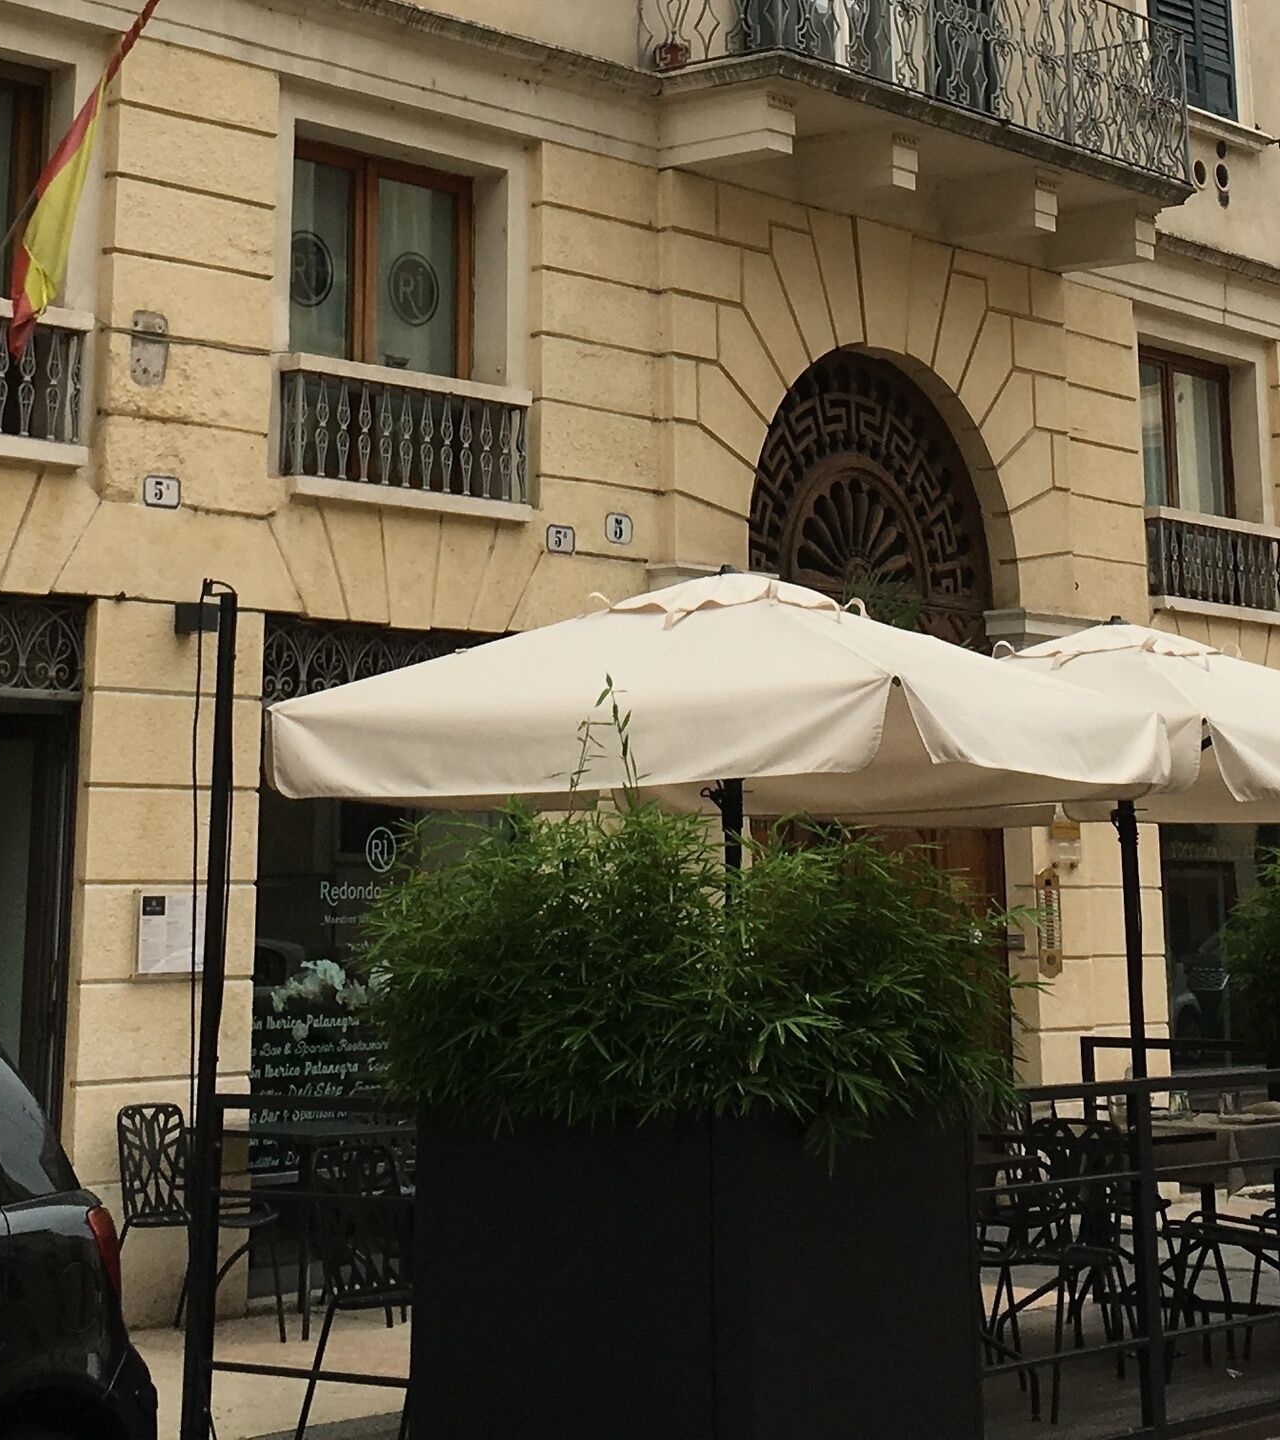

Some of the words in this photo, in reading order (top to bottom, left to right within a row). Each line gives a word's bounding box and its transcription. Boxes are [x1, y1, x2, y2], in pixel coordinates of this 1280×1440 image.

[613, 517, 624, 540] 5
[320, 880, 383, 906] Redondo
[295, 1040, 334, 1057] Spanish
[265, 1063, 300, 1078] Iberico
[304, 1061, 359, 1080] Palanegra
